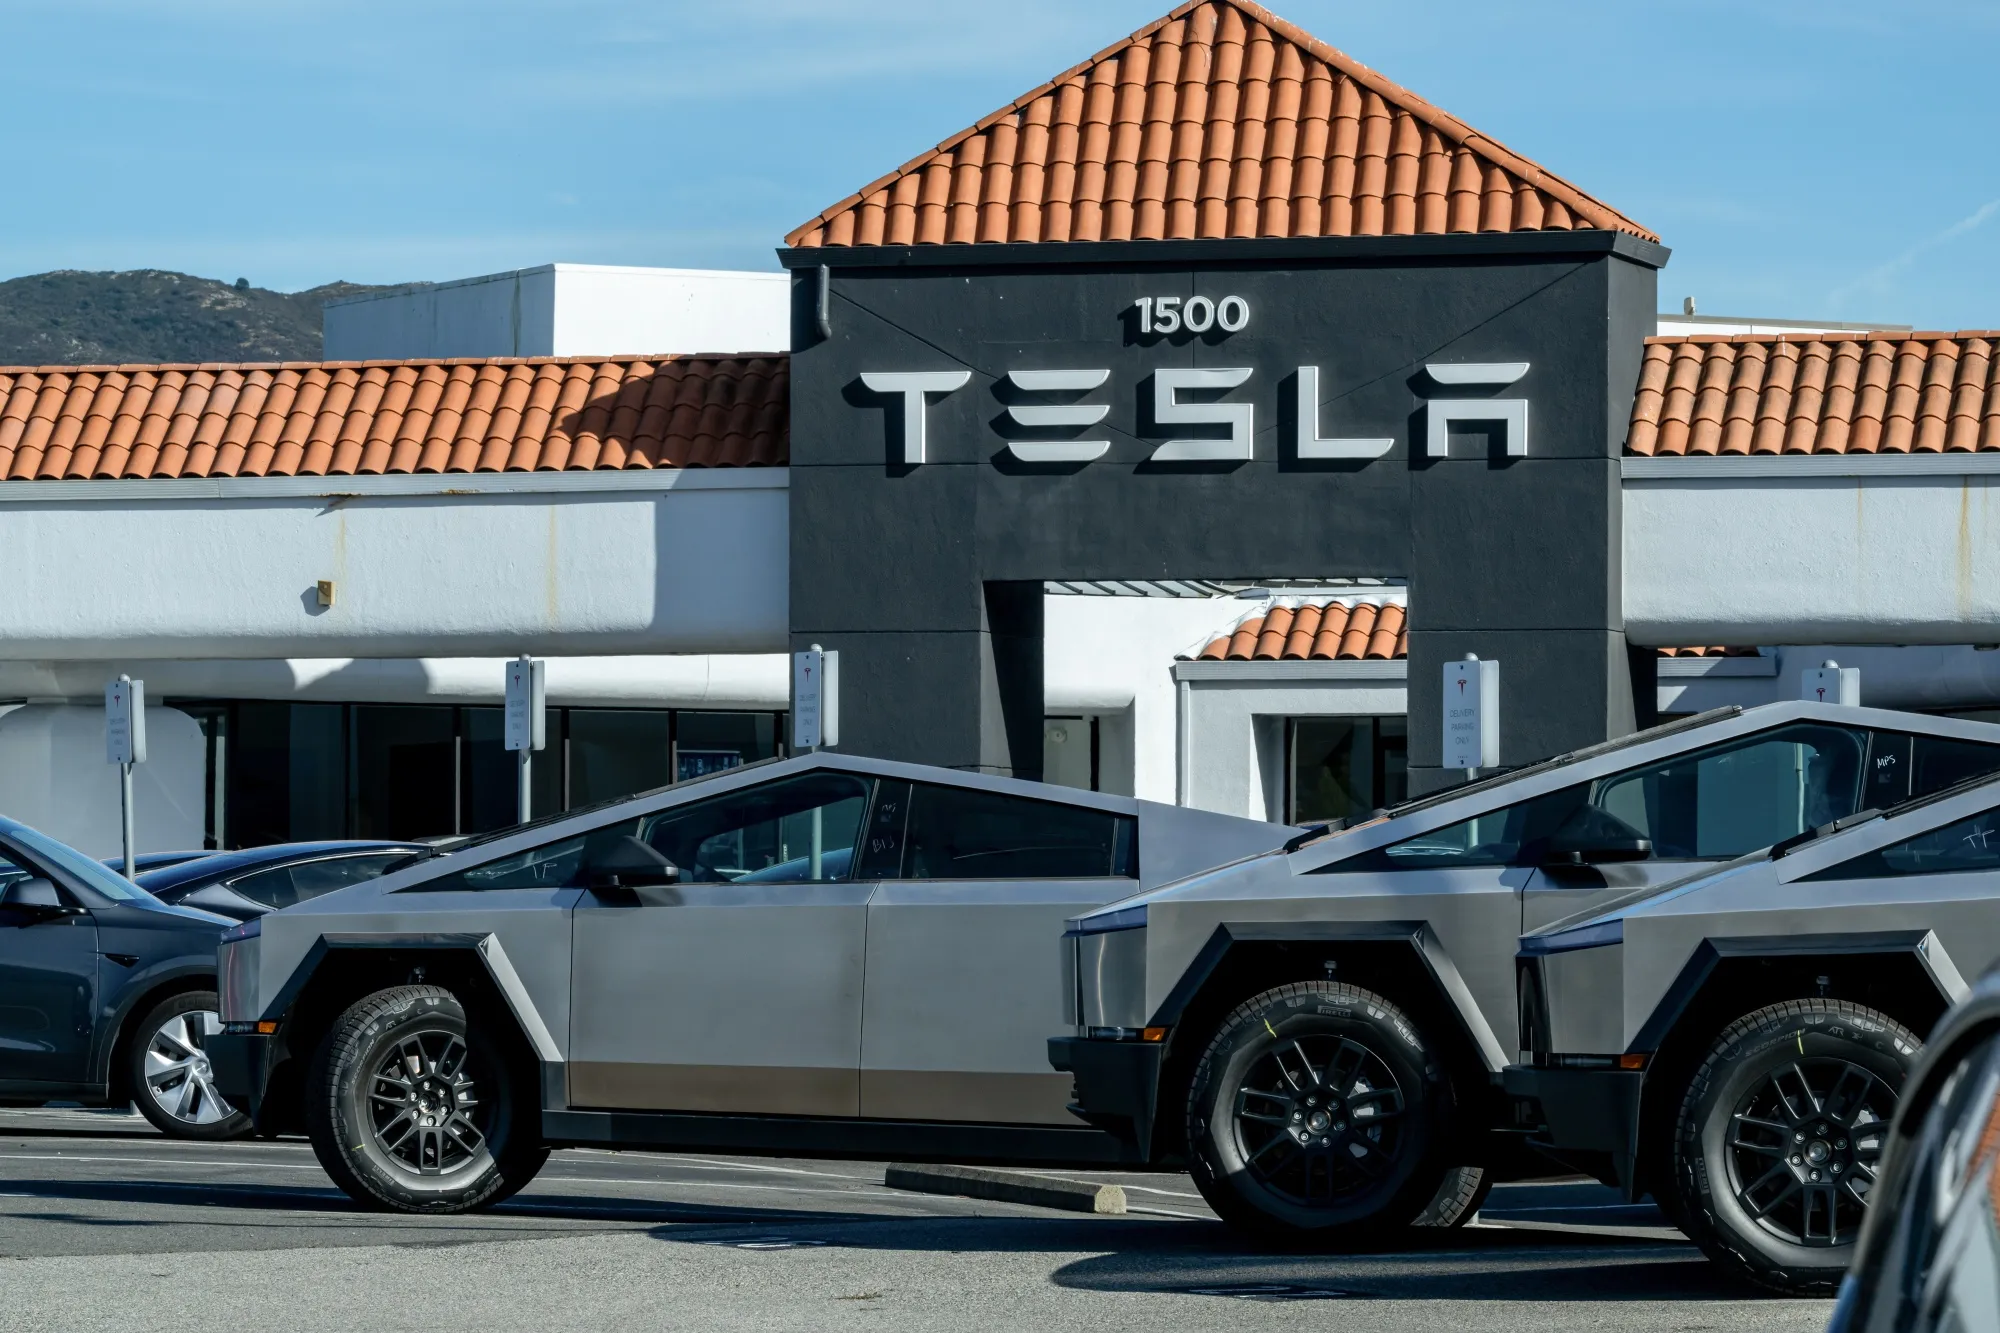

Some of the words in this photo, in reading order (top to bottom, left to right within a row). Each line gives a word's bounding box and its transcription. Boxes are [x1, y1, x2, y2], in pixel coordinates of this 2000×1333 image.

[1135, 295, 1250, 333] 1500
[859, 362, 1531, 464] TESLA
[1449, 708, 1475, 718] DELIVERY
[1451, 722, 1475, 731] PARKING
[1455, 736, 1470, 745] ONLY
[1877, 754, 1896, 769] MPS
[1828, 1026, 1845, 1038] ATR
